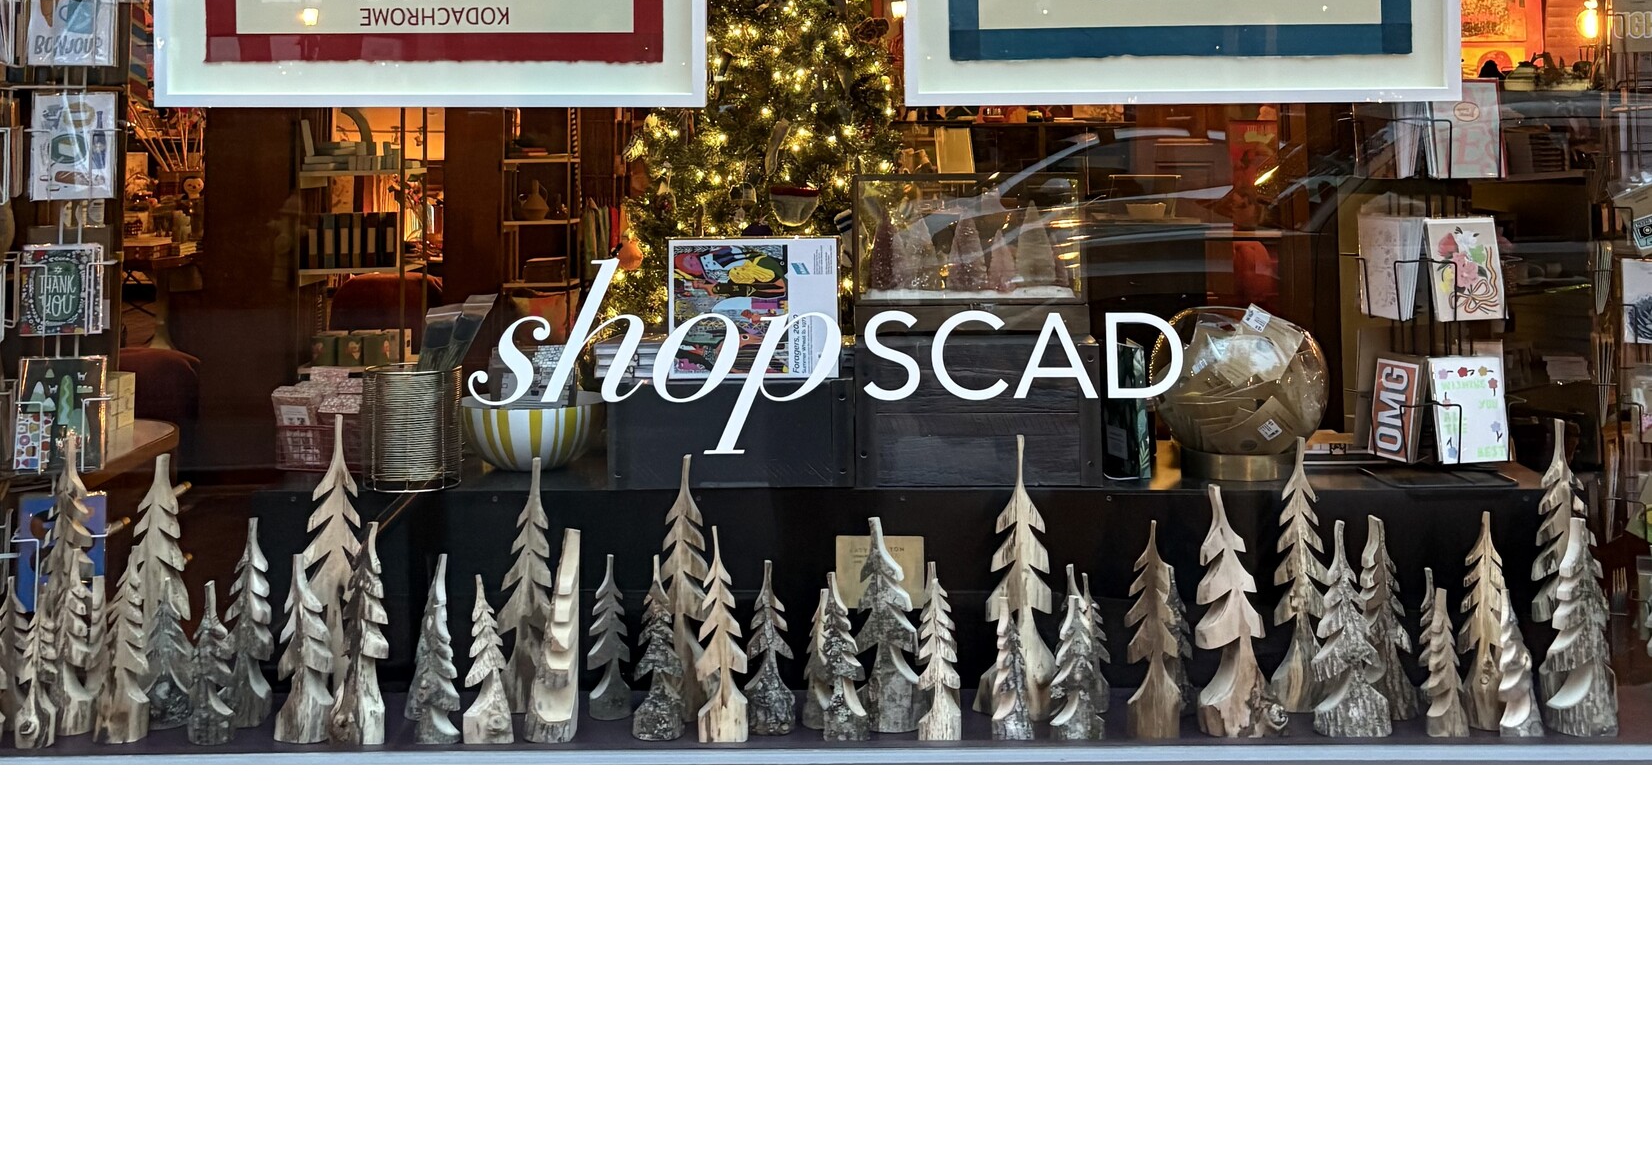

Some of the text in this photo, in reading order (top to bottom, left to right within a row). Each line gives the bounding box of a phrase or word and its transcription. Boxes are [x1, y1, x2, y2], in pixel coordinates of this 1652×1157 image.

[359, 6, 510, 27] KODACHROME
[34, 34, 103, 56] BONJOUR
[39, 275, 77, 294] THANK
[38, 294, 76, 317] YOU
[1374, 366, 1409, 453] OMG
